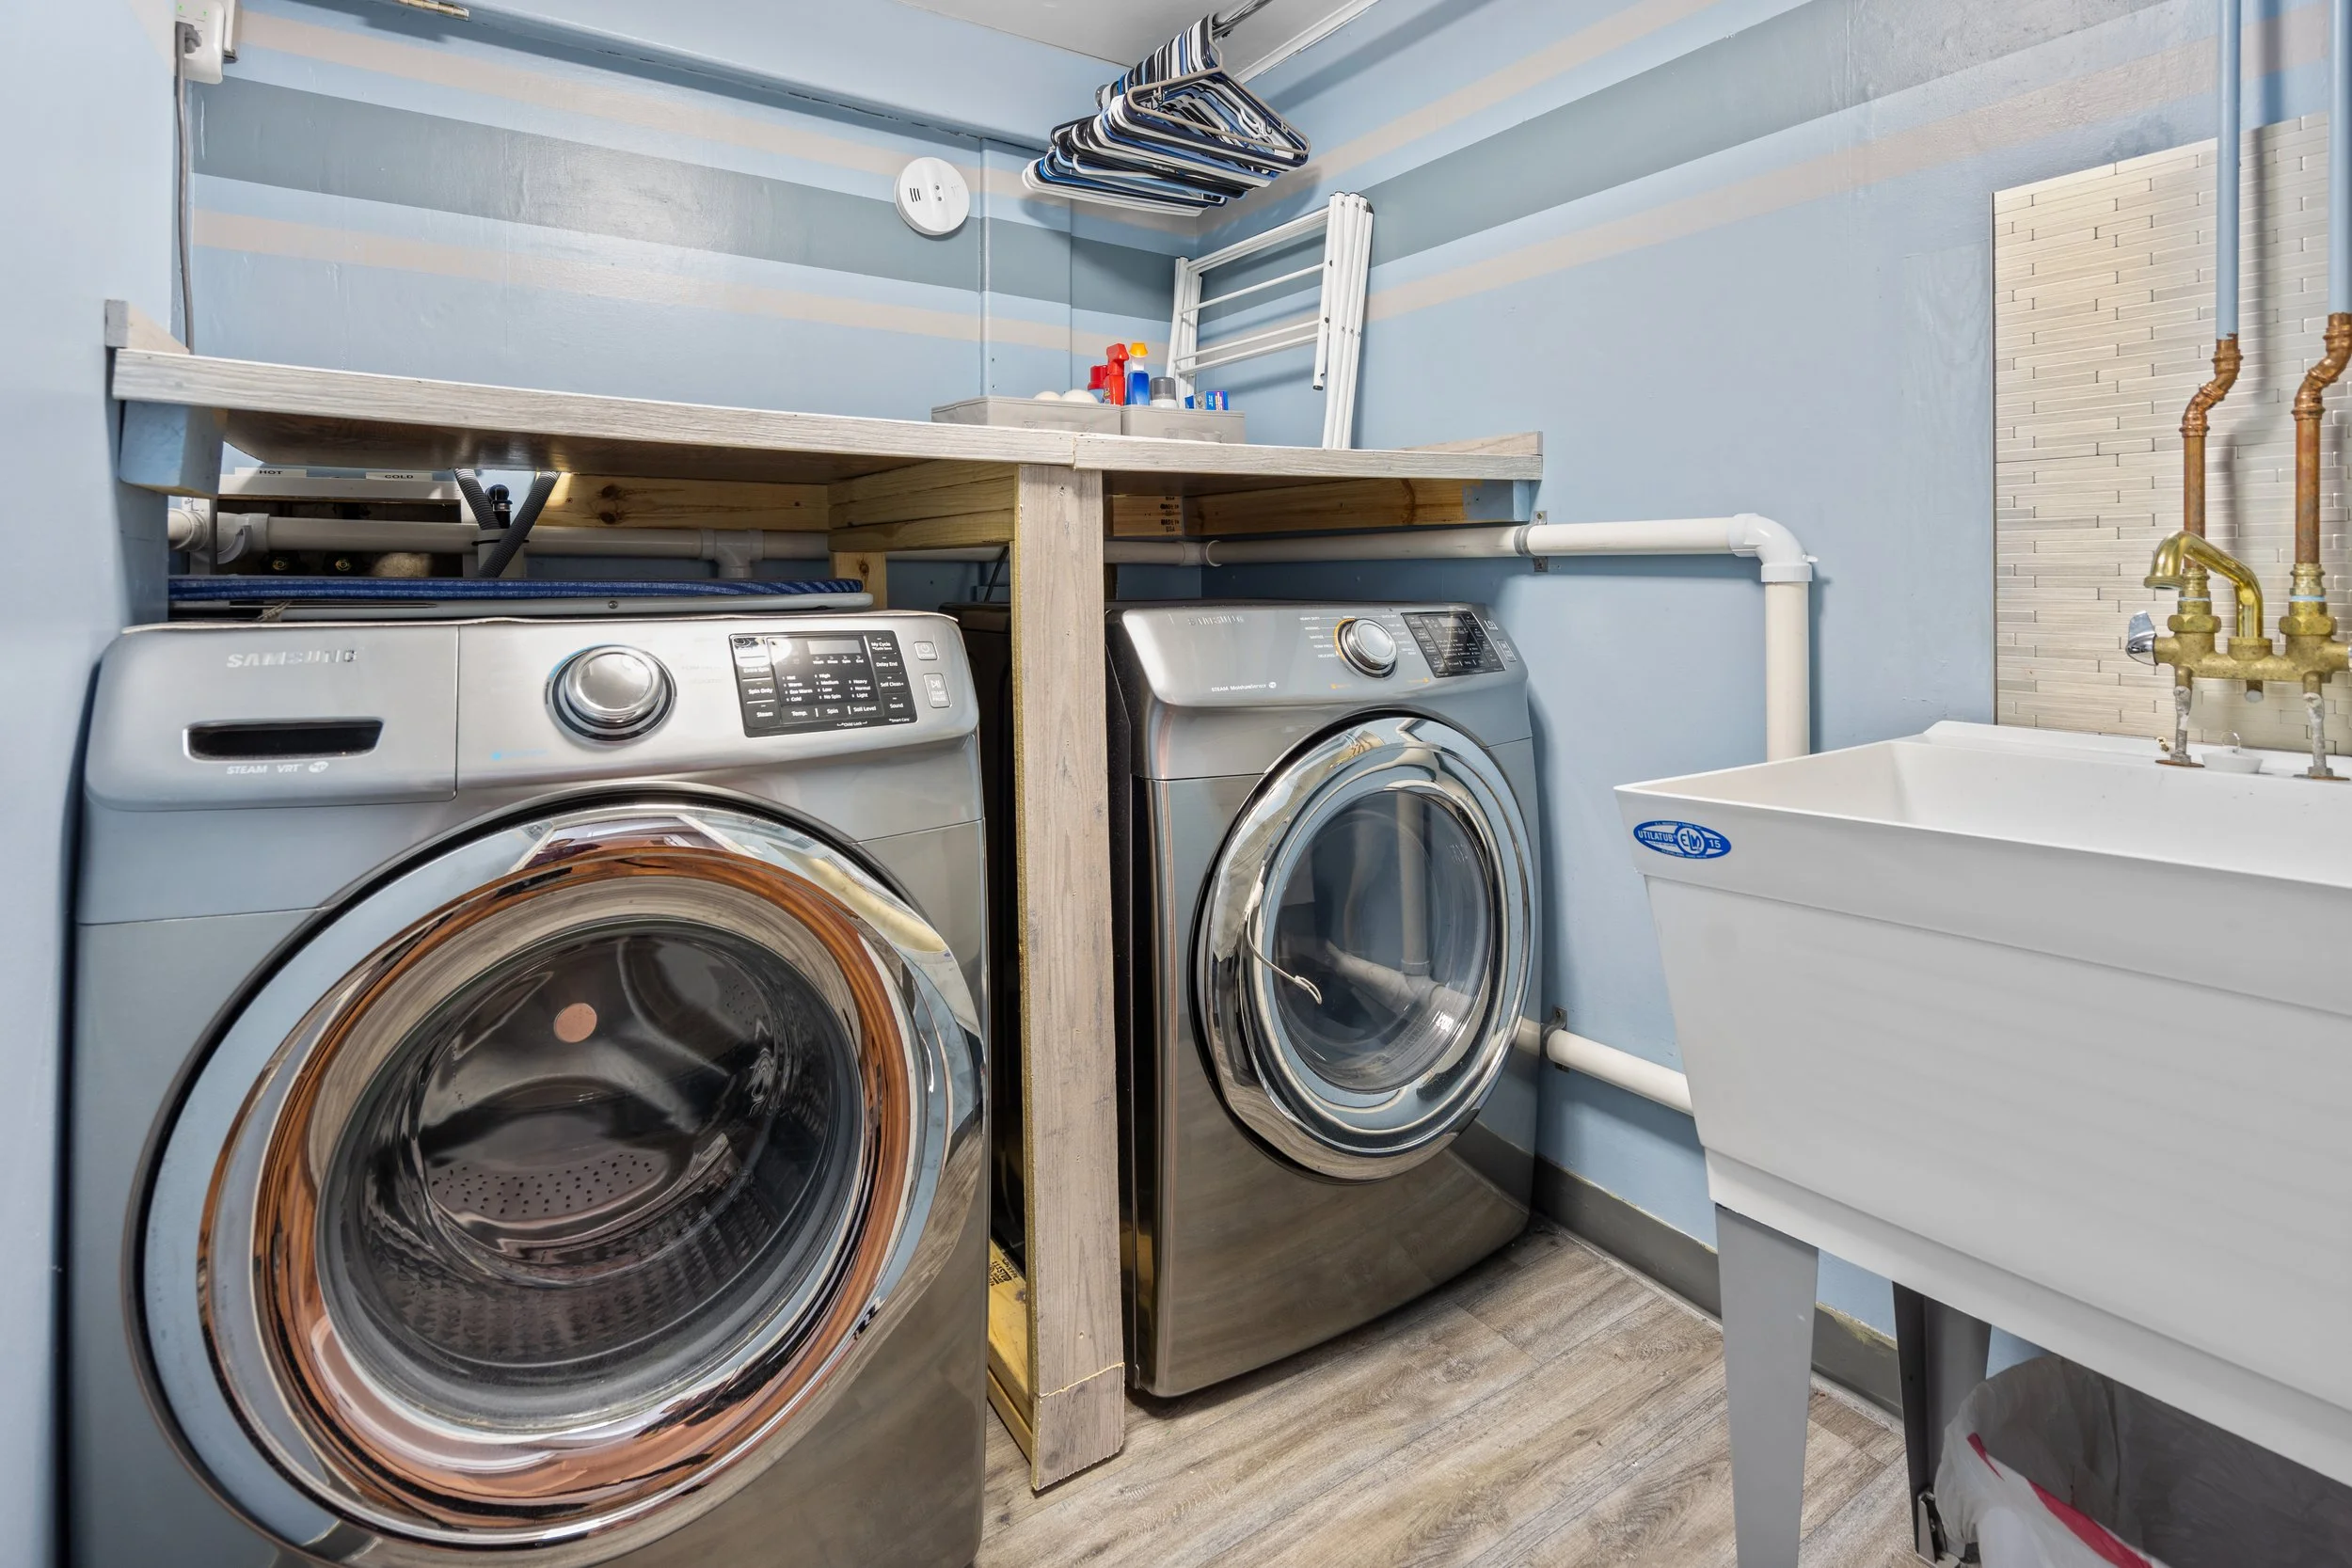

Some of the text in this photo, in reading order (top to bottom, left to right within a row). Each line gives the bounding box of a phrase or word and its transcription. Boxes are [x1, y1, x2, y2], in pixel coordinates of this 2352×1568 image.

[226, 765, 268, 775] STEAM
[1637, 830, 1675, 843] UTILATUB
[1708, 839, 1722, 848] 15
